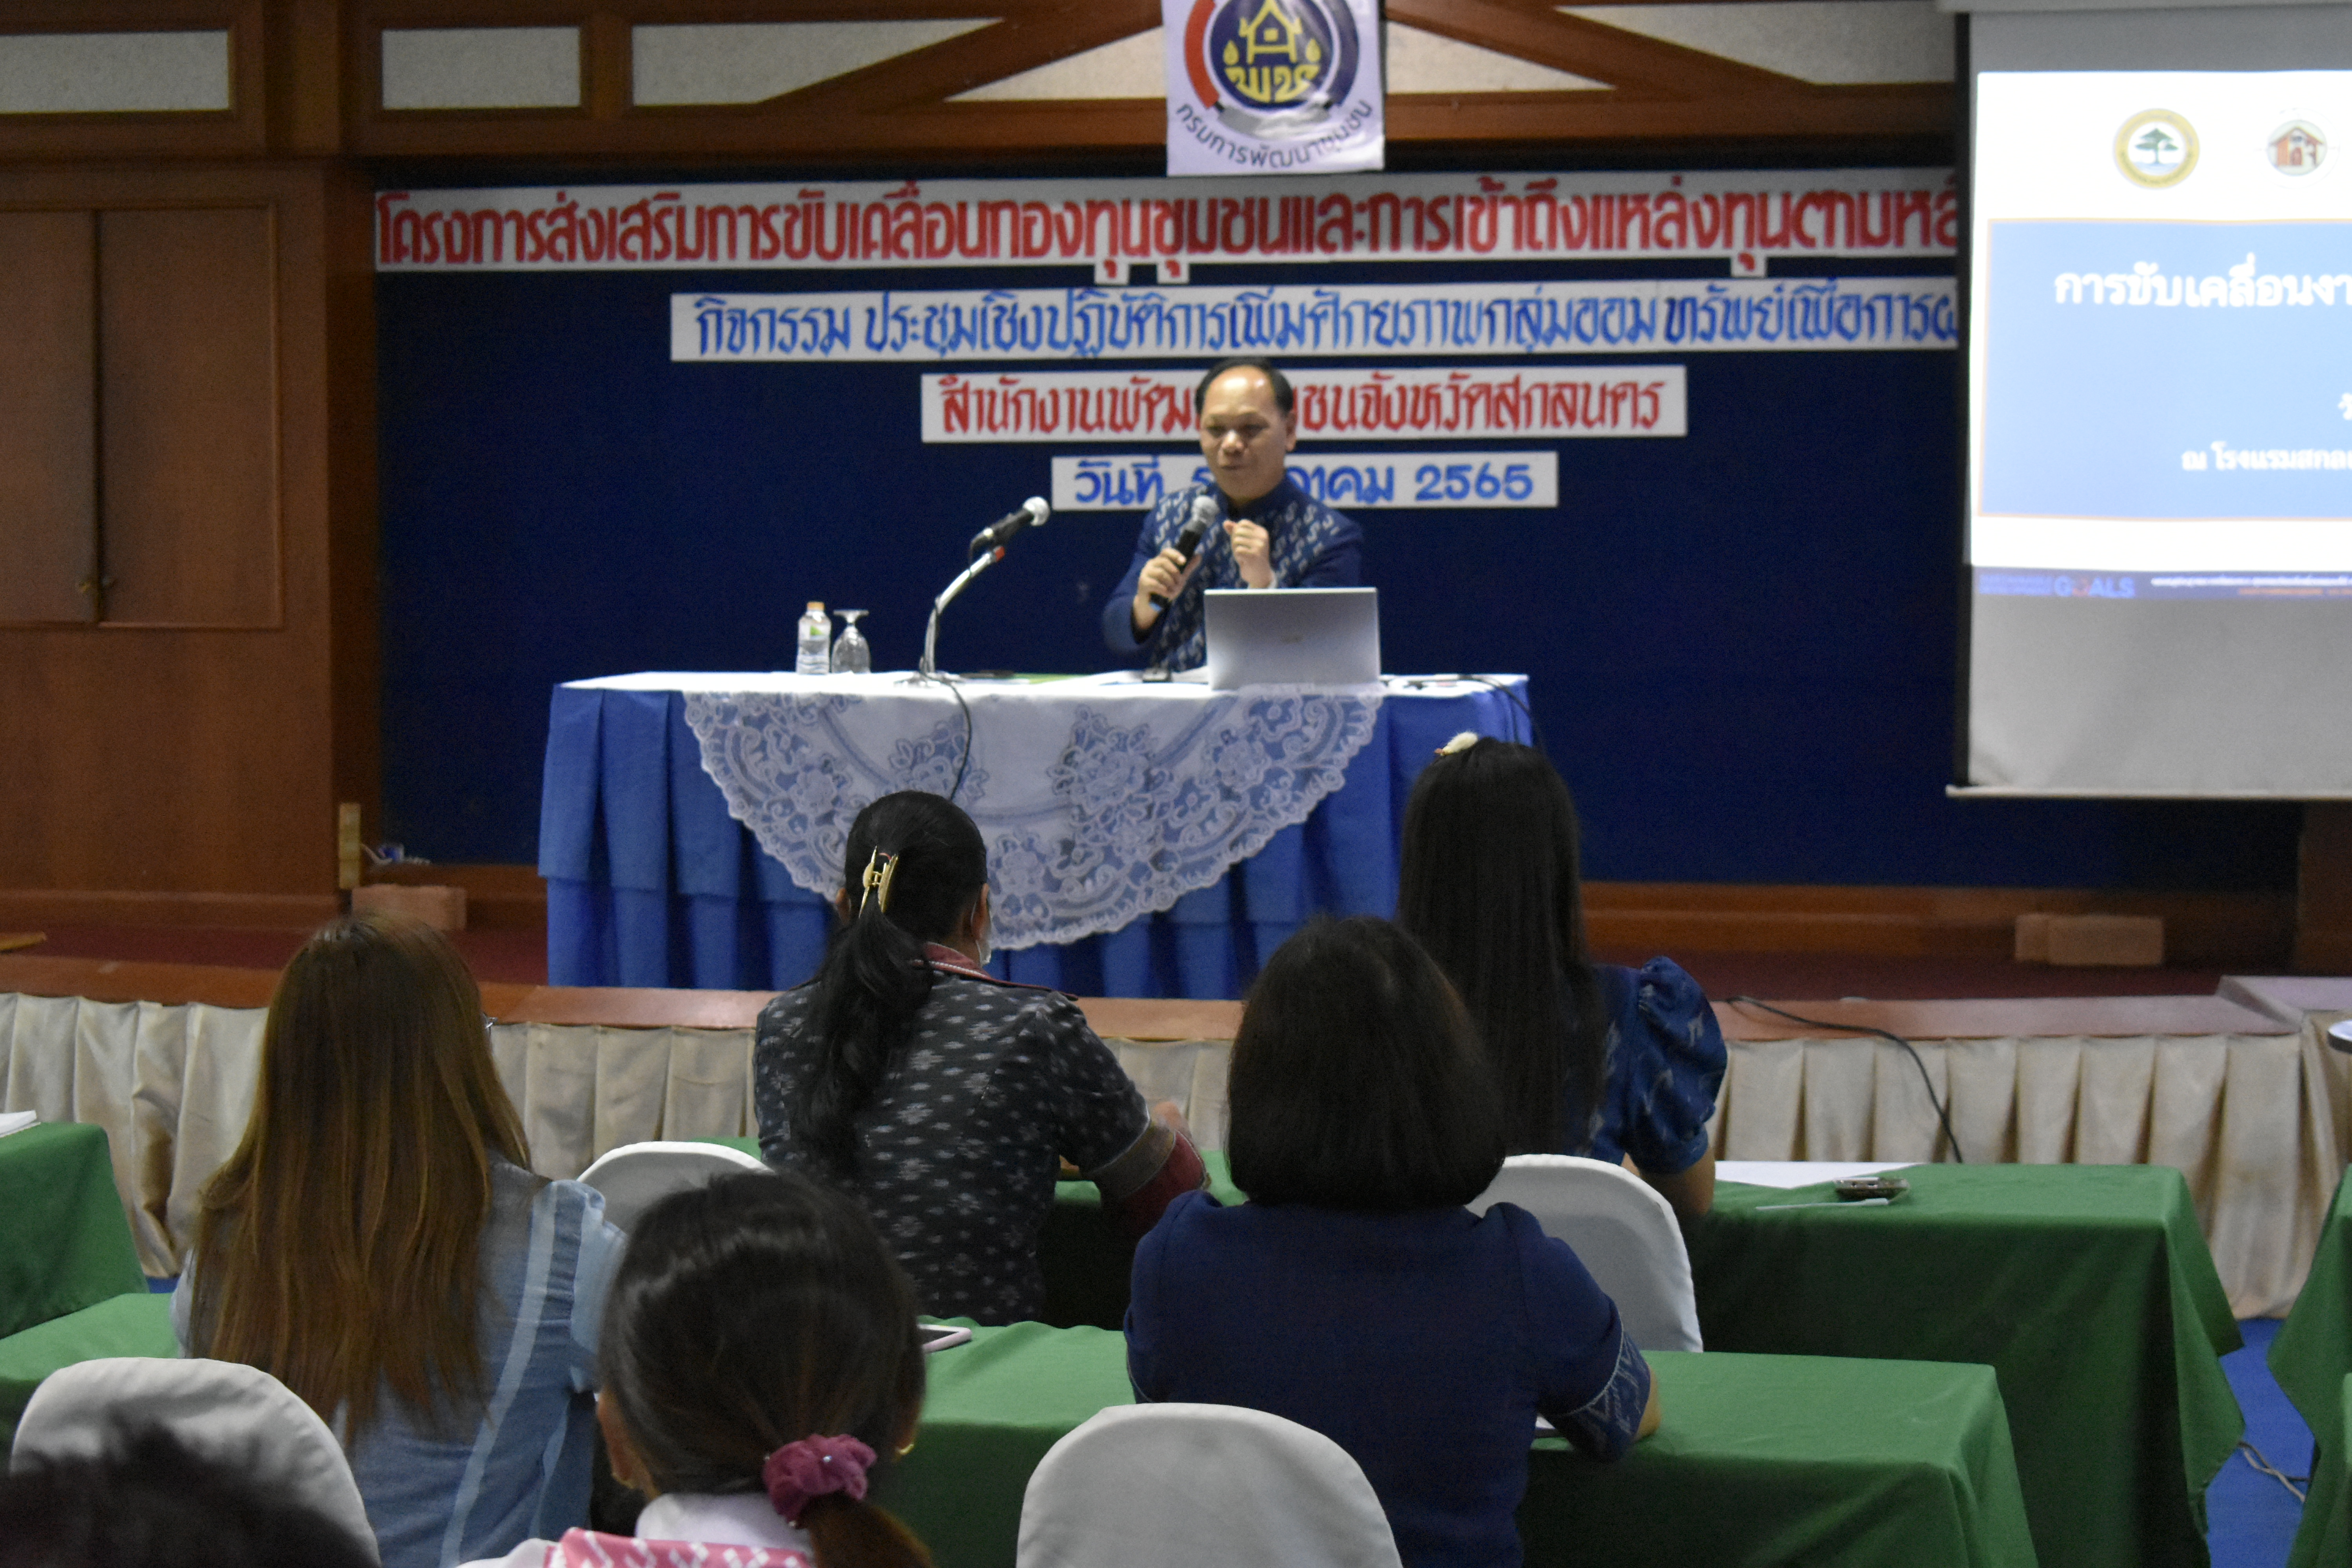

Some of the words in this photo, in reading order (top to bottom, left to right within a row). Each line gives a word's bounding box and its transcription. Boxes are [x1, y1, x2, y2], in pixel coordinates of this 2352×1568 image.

[2211, 441, 2352, 470] โรงแรมสกล
[1075, 455, 1164, 505] วันที่
[1415, 462, 1533, 501] 2565
